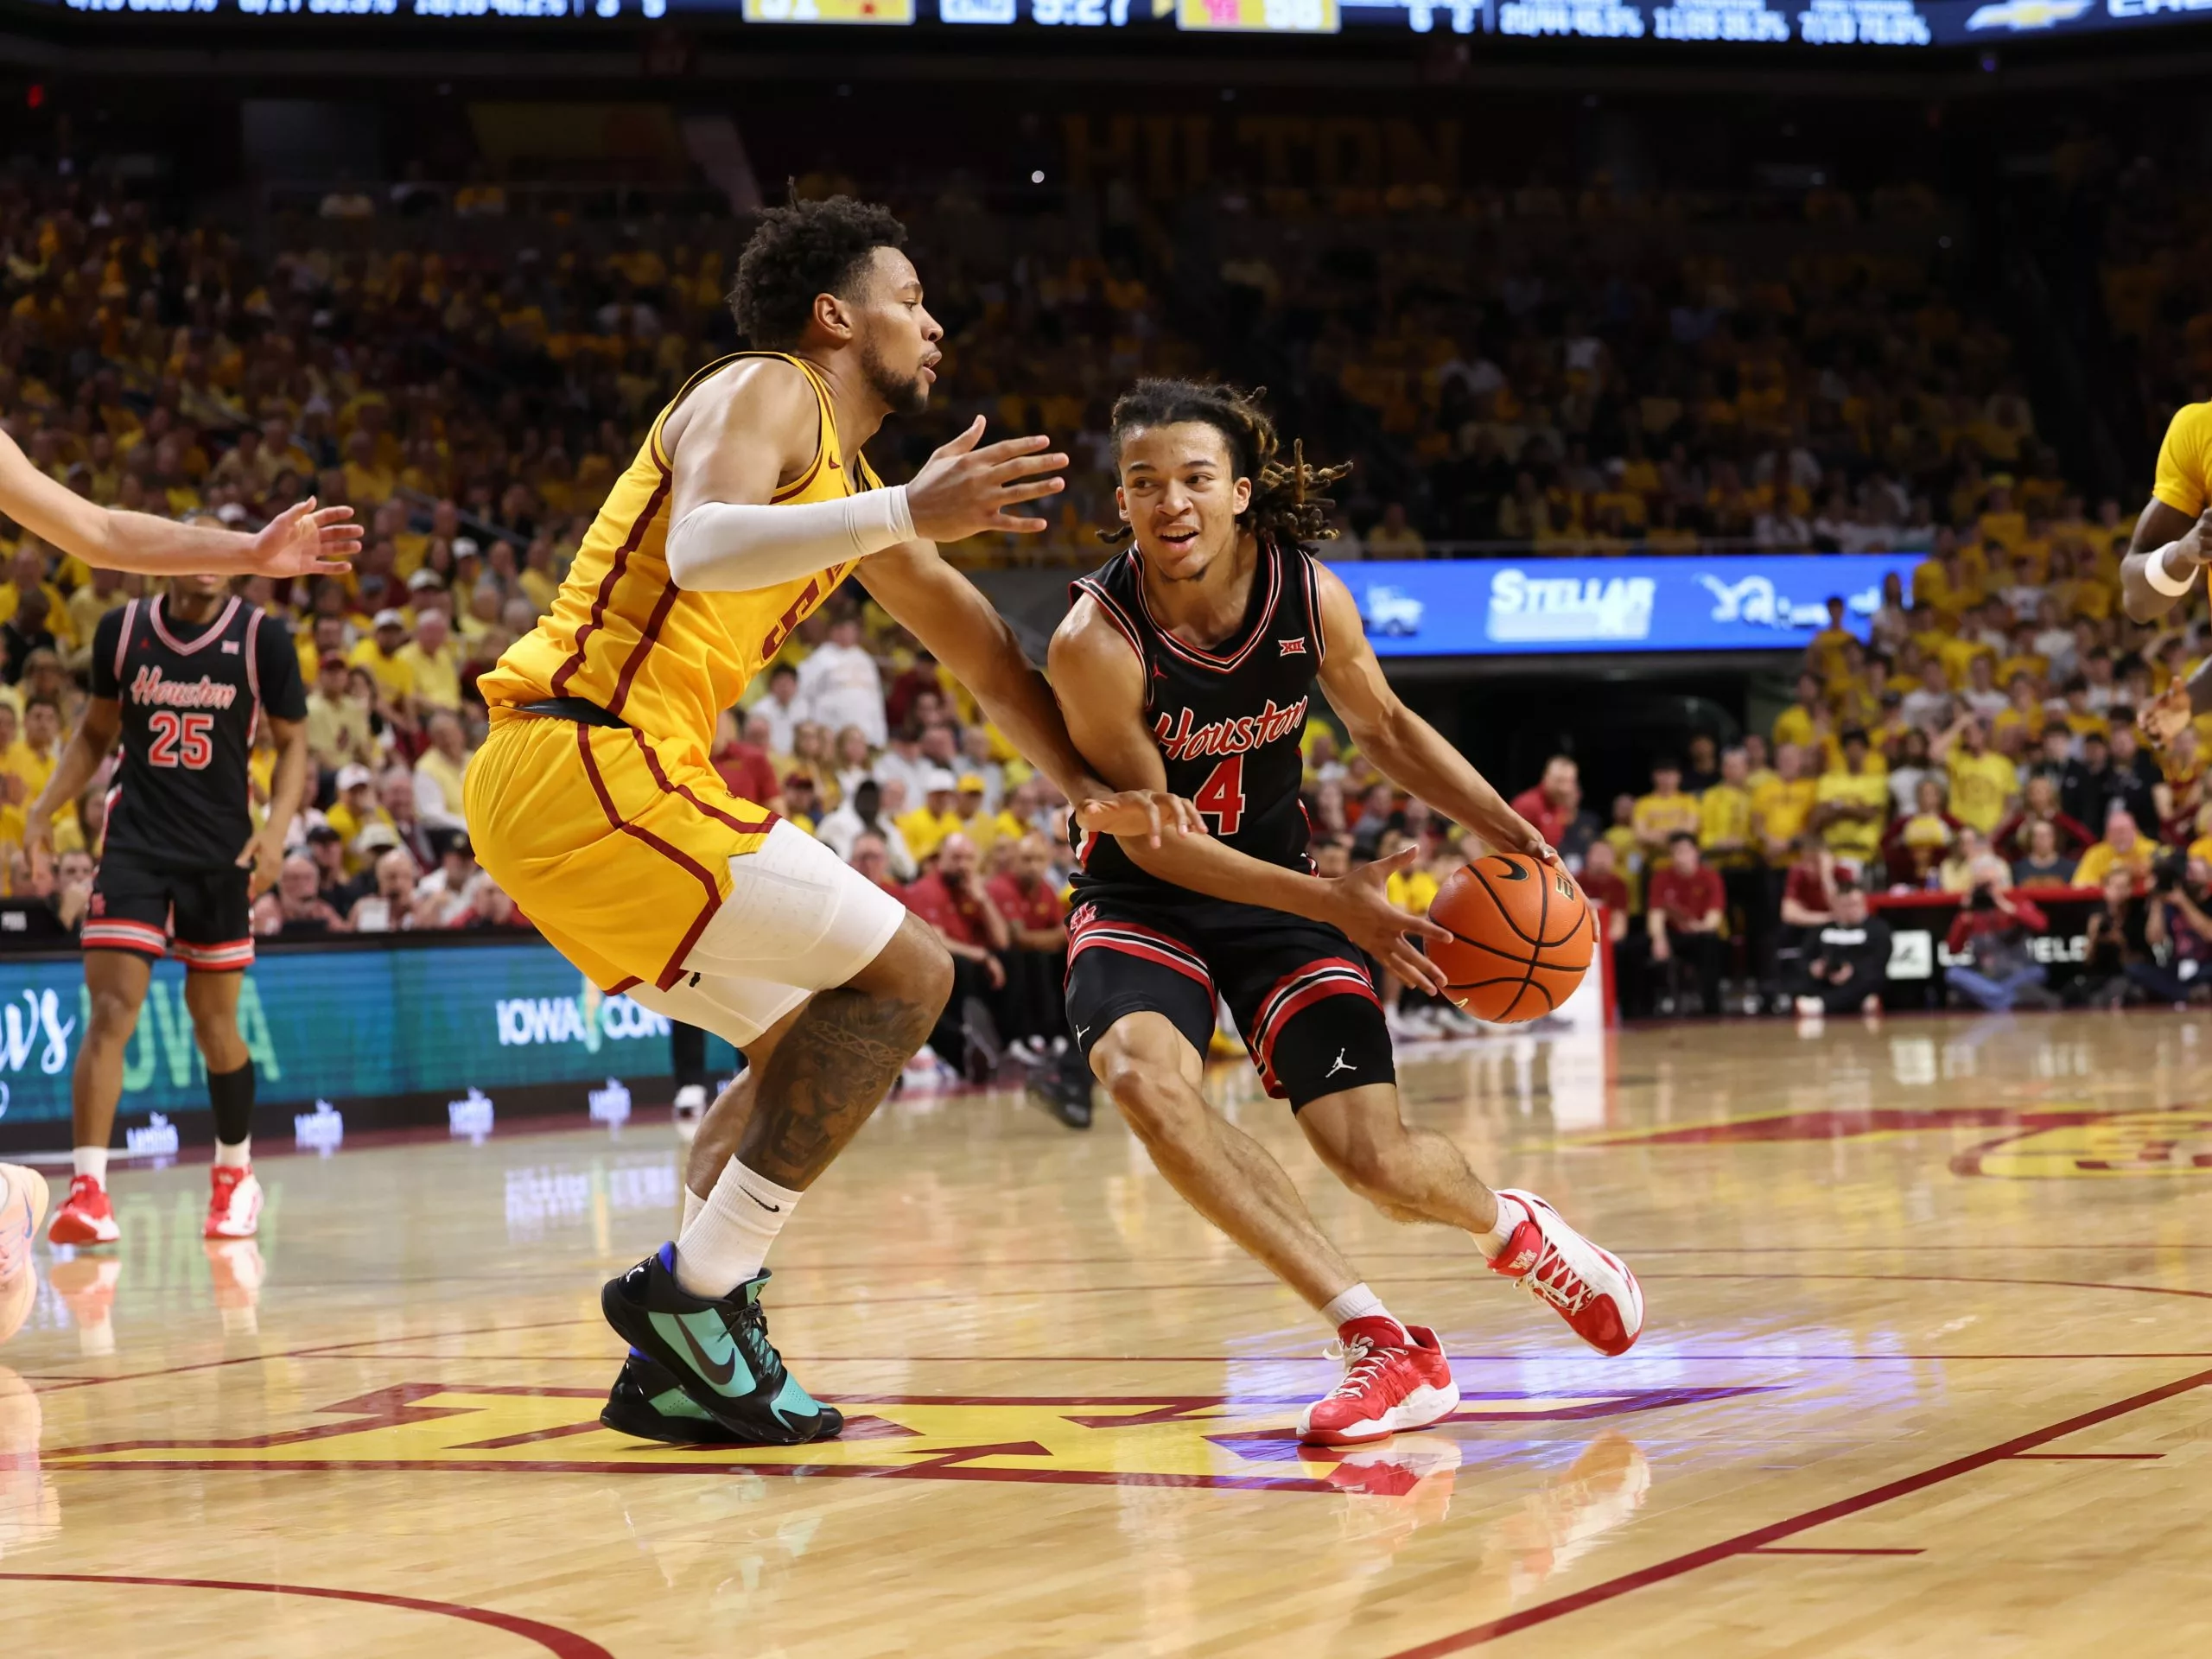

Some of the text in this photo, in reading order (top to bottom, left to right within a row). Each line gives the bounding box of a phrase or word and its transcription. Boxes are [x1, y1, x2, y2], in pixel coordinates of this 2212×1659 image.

[130, 664, 237, 709] Houston
[148, 710, 213, 770] 25
[1154, 695, 1308, 761] Houston
[1193, 753, 1246, 836] 4
[496, 996, 584, 1046] IOWA
